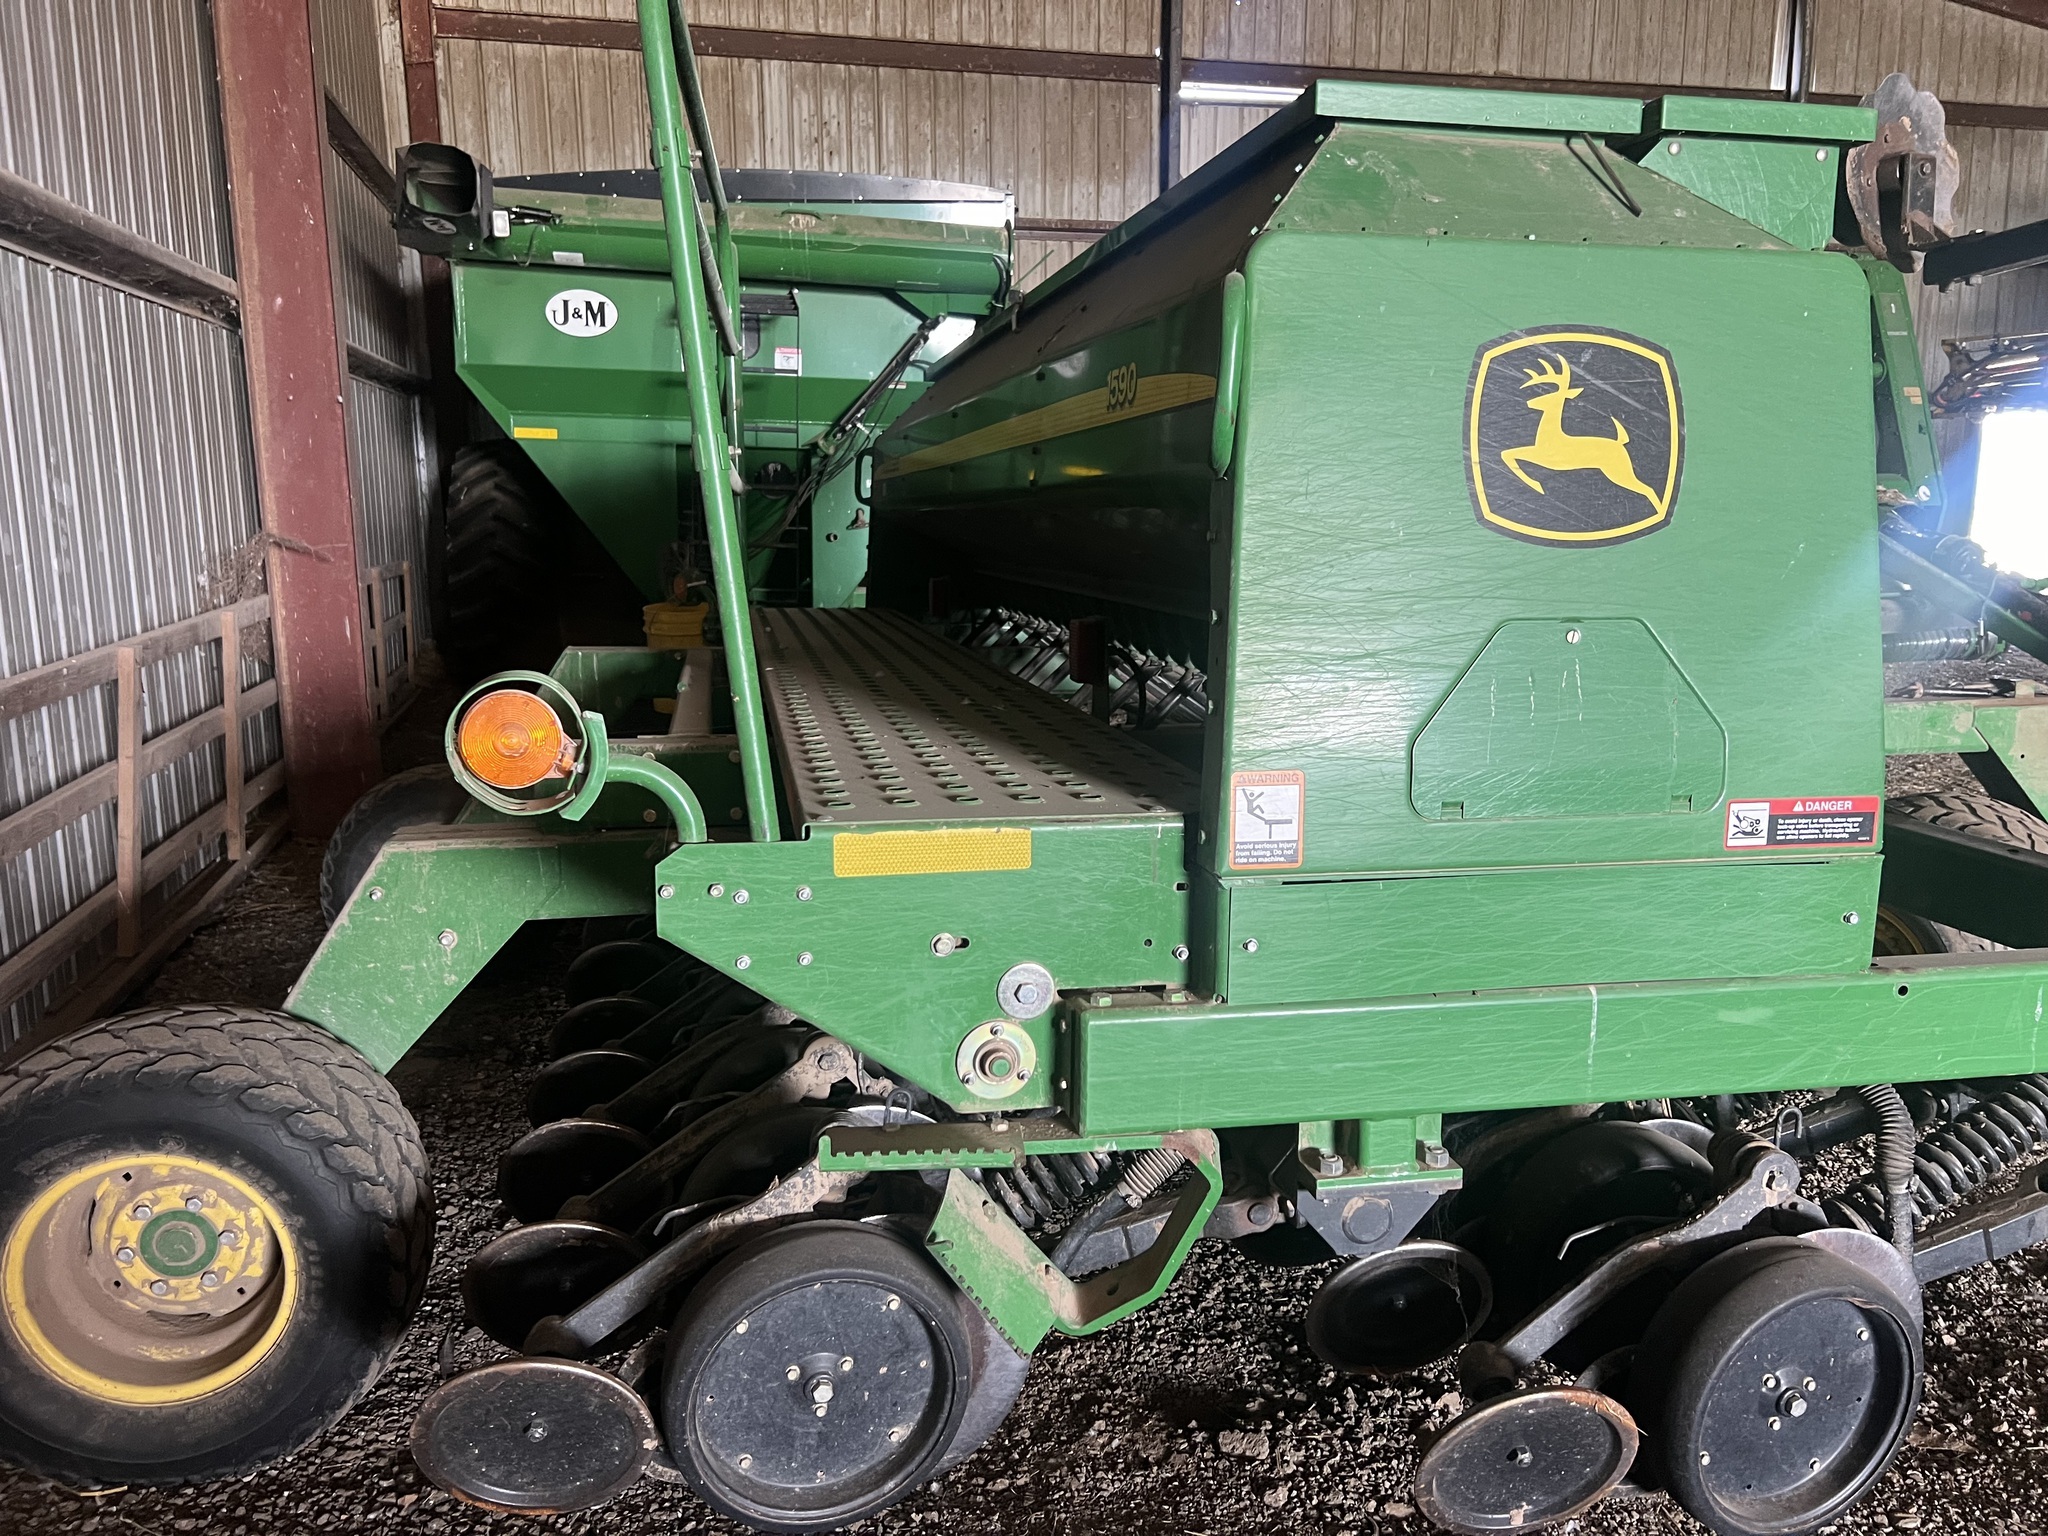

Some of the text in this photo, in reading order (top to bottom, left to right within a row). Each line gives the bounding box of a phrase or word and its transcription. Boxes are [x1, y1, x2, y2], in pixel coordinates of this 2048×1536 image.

[552, 299, 607, 327] J&M
[1247, 773, 1300, 783] WARNING
[1805, 800, 1853, 812] DANGER
